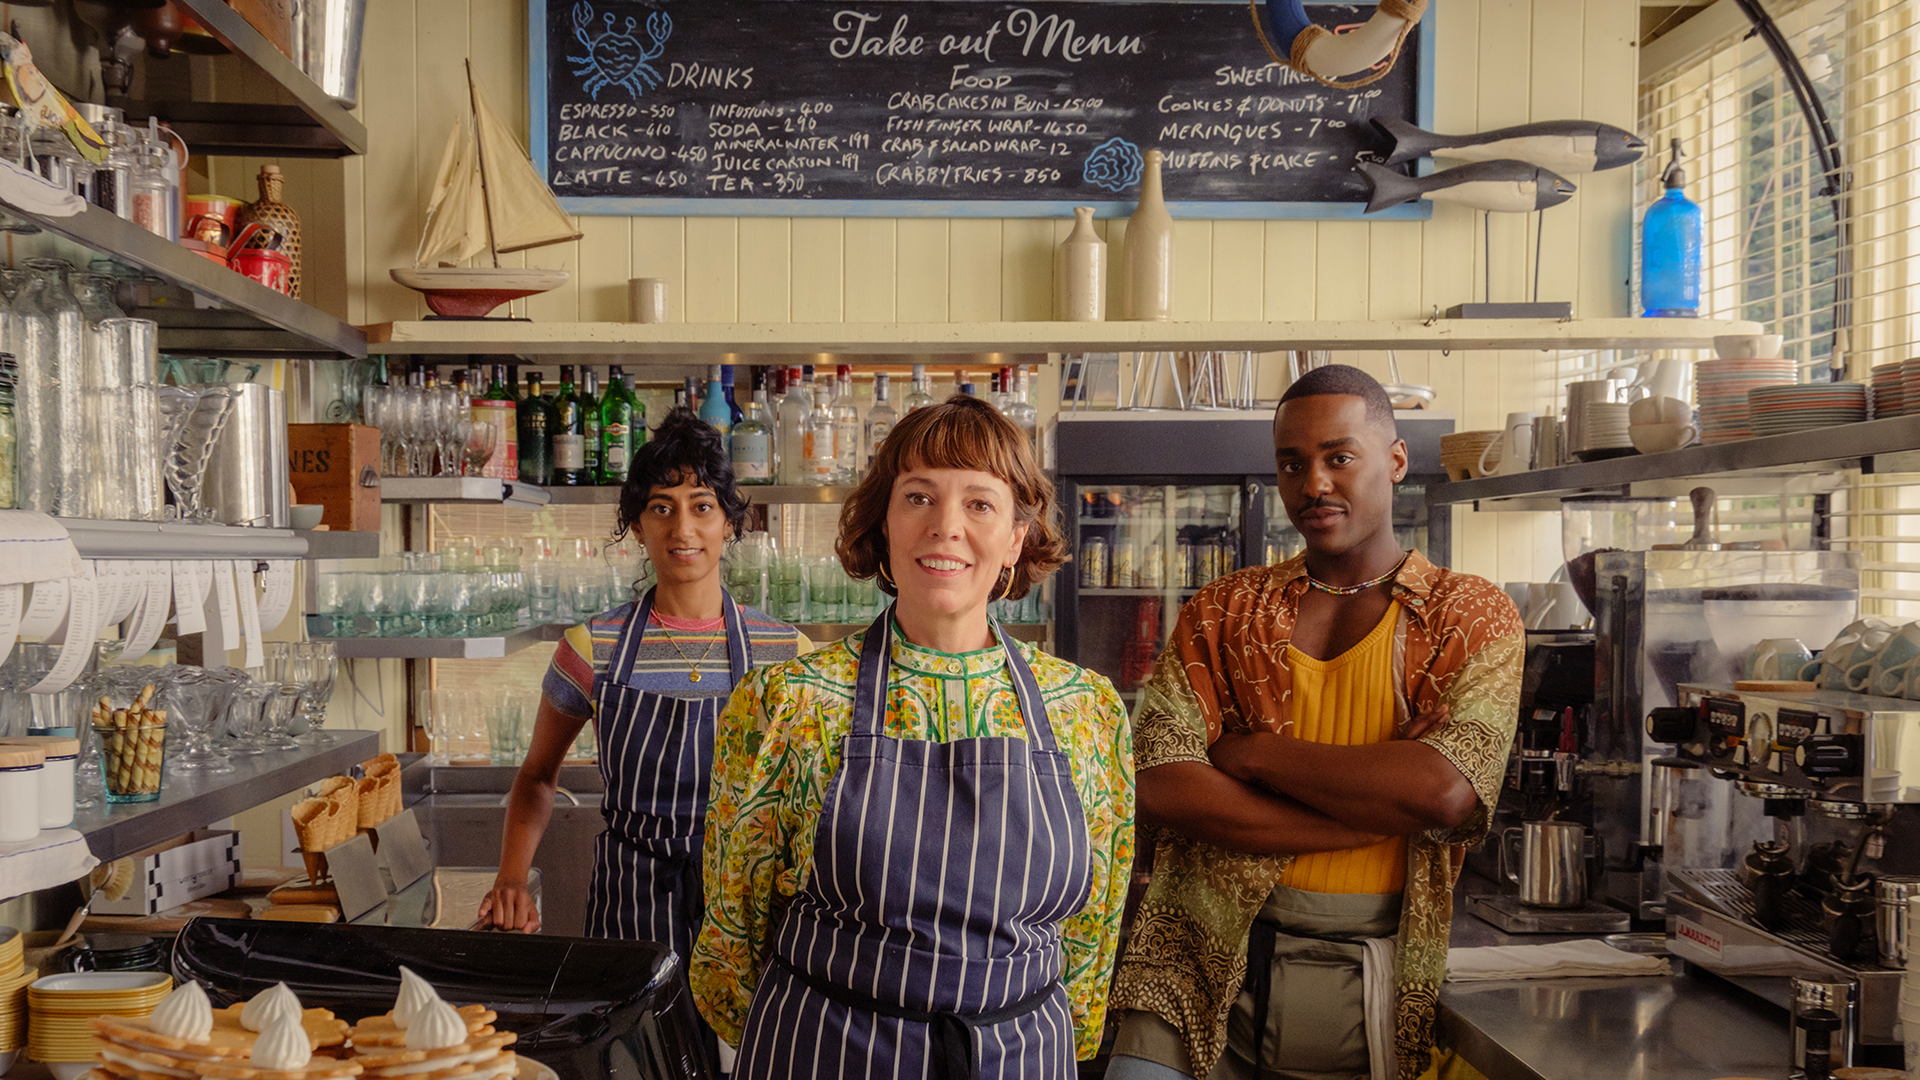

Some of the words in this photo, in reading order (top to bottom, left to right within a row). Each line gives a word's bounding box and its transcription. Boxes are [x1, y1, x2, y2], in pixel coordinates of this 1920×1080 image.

[829, 9, 924, 58] Take
[938, 20, 1001, 63] out
[1006, 8, 1142, 62] Menu
[667, 62, 754, 89] DRINKS
[1215, 62, 1280, 86] SWEET
[560, 103, 637, 120] ESPRESSO
[1014, 94, 1050, 112] BUN
[1158, 95, 1234, 113] COOKIES
[1257, 93, 1329, 113] DONUTS
[558, 123, 628, 141] BLACK
[708, 122, 761, 138] SODA
[886, 115, 924, 133] FISH
[926, 118, 983, 136] FINGER
[988, 118, 1034, 133] WRAP
[1158, 121, 1282, 146] MERINGUES
[555, 144, 666, 162] CAPPUCINO
[881, 137, 924, 159] CRAB
[941, 139, 992, 154] SALAD
[993, 138, 1040, 155] WRAP
[711, 153, 762, 172] JUICE
[553, 166, 632, 186] LATTE
[706, 173, 755, 193] TEA
[876, 162, 951, 186] CRABBY
[953, 165, 1004, 184] FRIES
